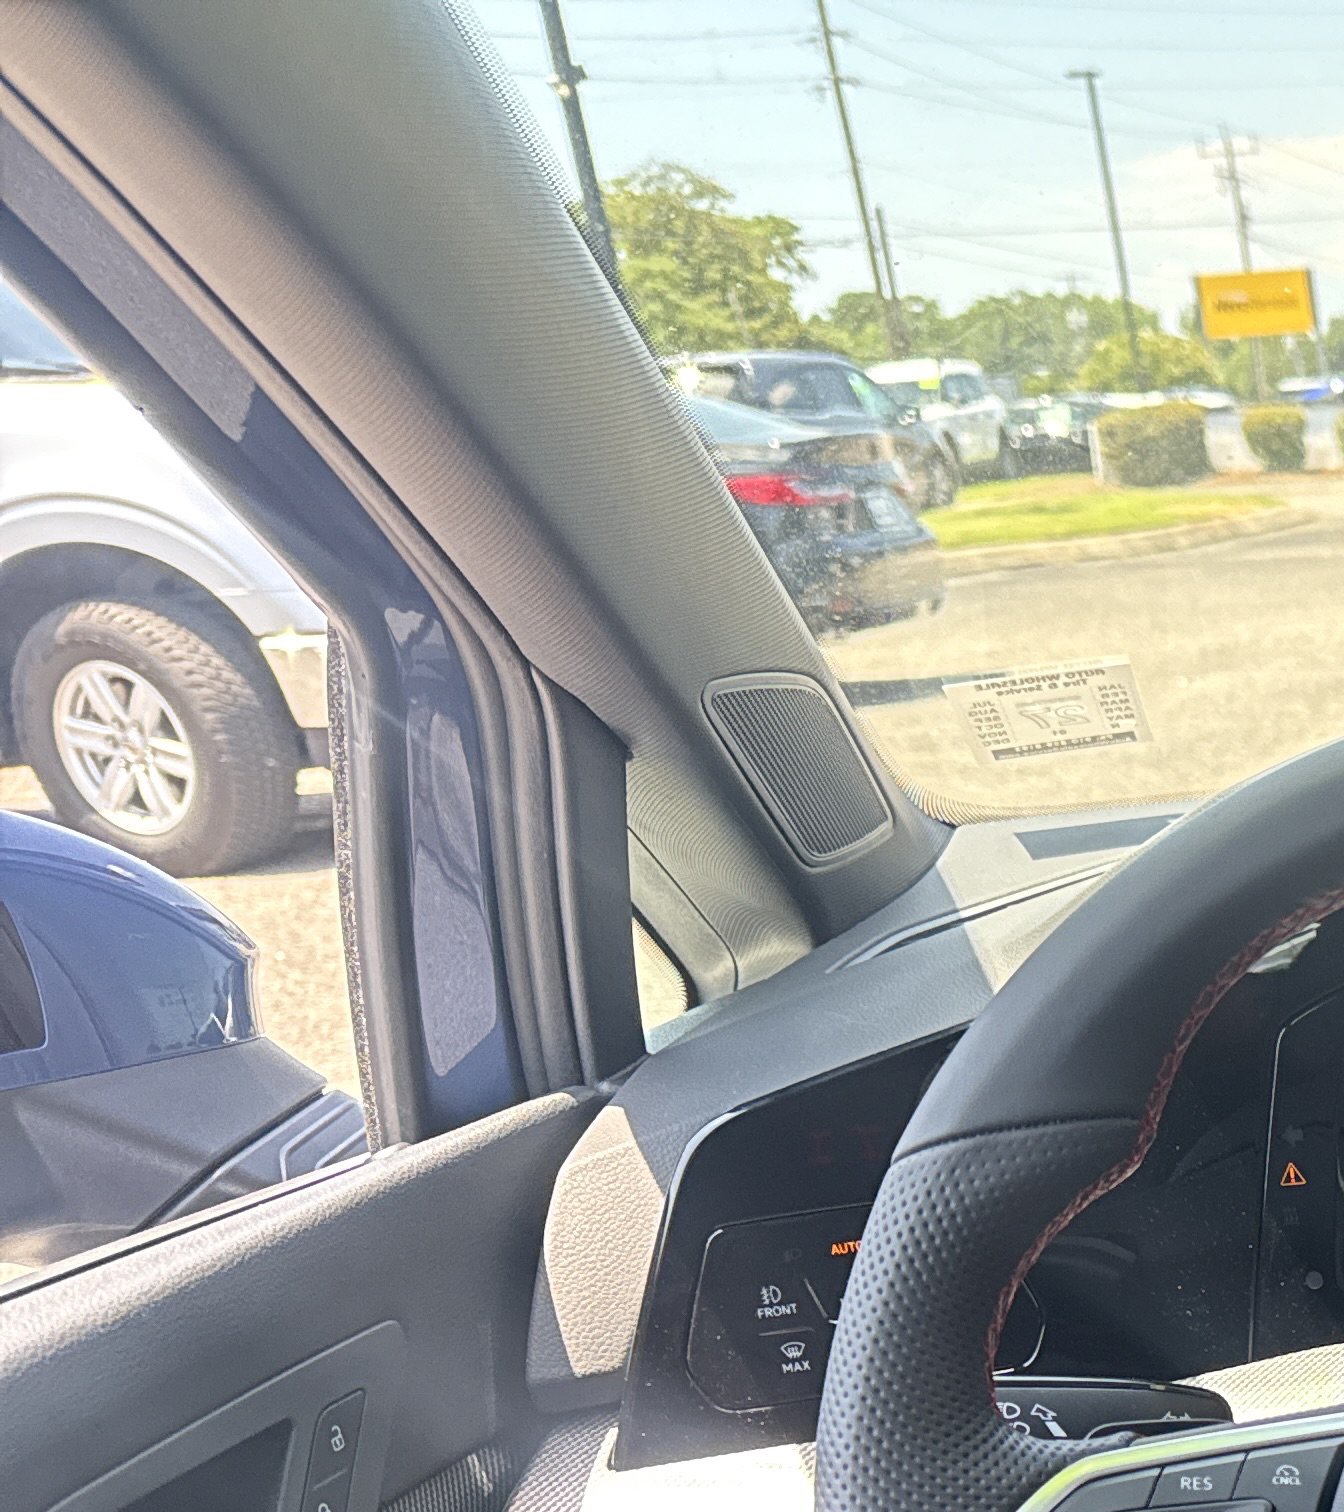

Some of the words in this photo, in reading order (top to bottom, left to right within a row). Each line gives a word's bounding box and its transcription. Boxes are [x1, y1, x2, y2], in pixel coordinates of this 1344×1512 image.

[757, 1303, 797, 1319] FRONT
[782, 1360, 811, 1374] MAX
[1180, 1476, 1213, 1491] RES
[1272, 1476, 1301, 1486] CNCL
